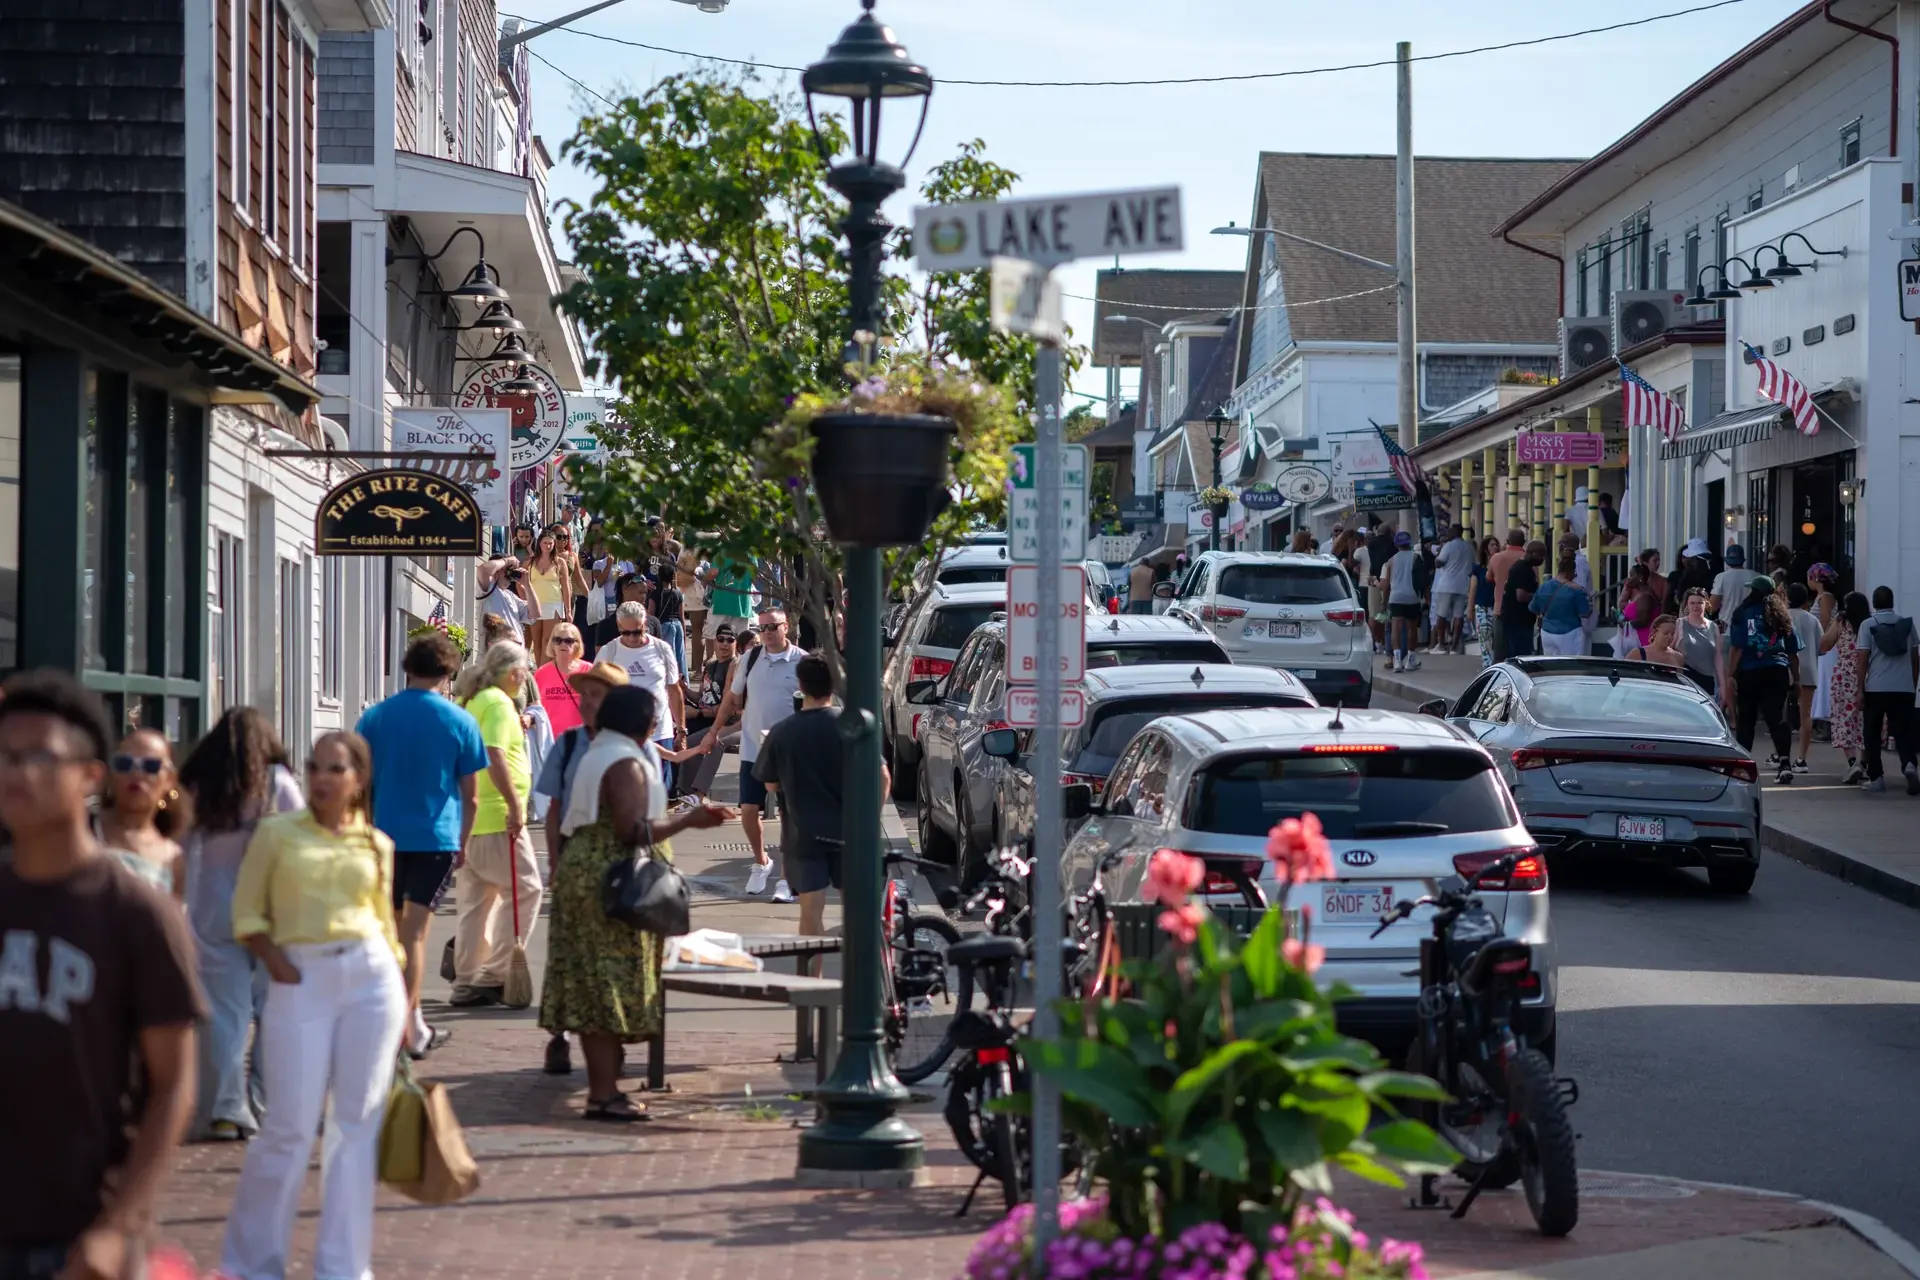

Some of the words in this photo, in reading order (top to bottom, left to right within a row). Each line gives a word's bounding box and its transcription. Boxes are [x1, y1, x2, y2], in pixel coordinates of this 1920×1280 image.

[977, 204, 1073, 256] LAKE
[1104, 197, 1175, 247] AVE
[461, 382, 481, 408] RED
[481, 366, 507, 384] CAT
[437, 416, 463, 430] The
[407, 432, 455, 445] BLACK
[459, 433, 493, 445] DOG
[535, 436, 551, 451] MA
[1526, 435, 1565, 448] M&R
[1524, 448, 1566, 460] STYLZ
[326, 486, 366, 521] THE
[368, 476, 420, 494] RITZ
[424, 483, 473, 522] CAFE
[350, 535, 415, 545] Established
[419, 536, 447, 545] 1944
[1620, 821, 1646, 834] 6JVW
[1650, 823, 1663, 835] 88
[1347, 852, 1372, 863] KIA
[1326, 894, 1366, 913] 6NDF
[1371, 894, 1391, 913] 34
